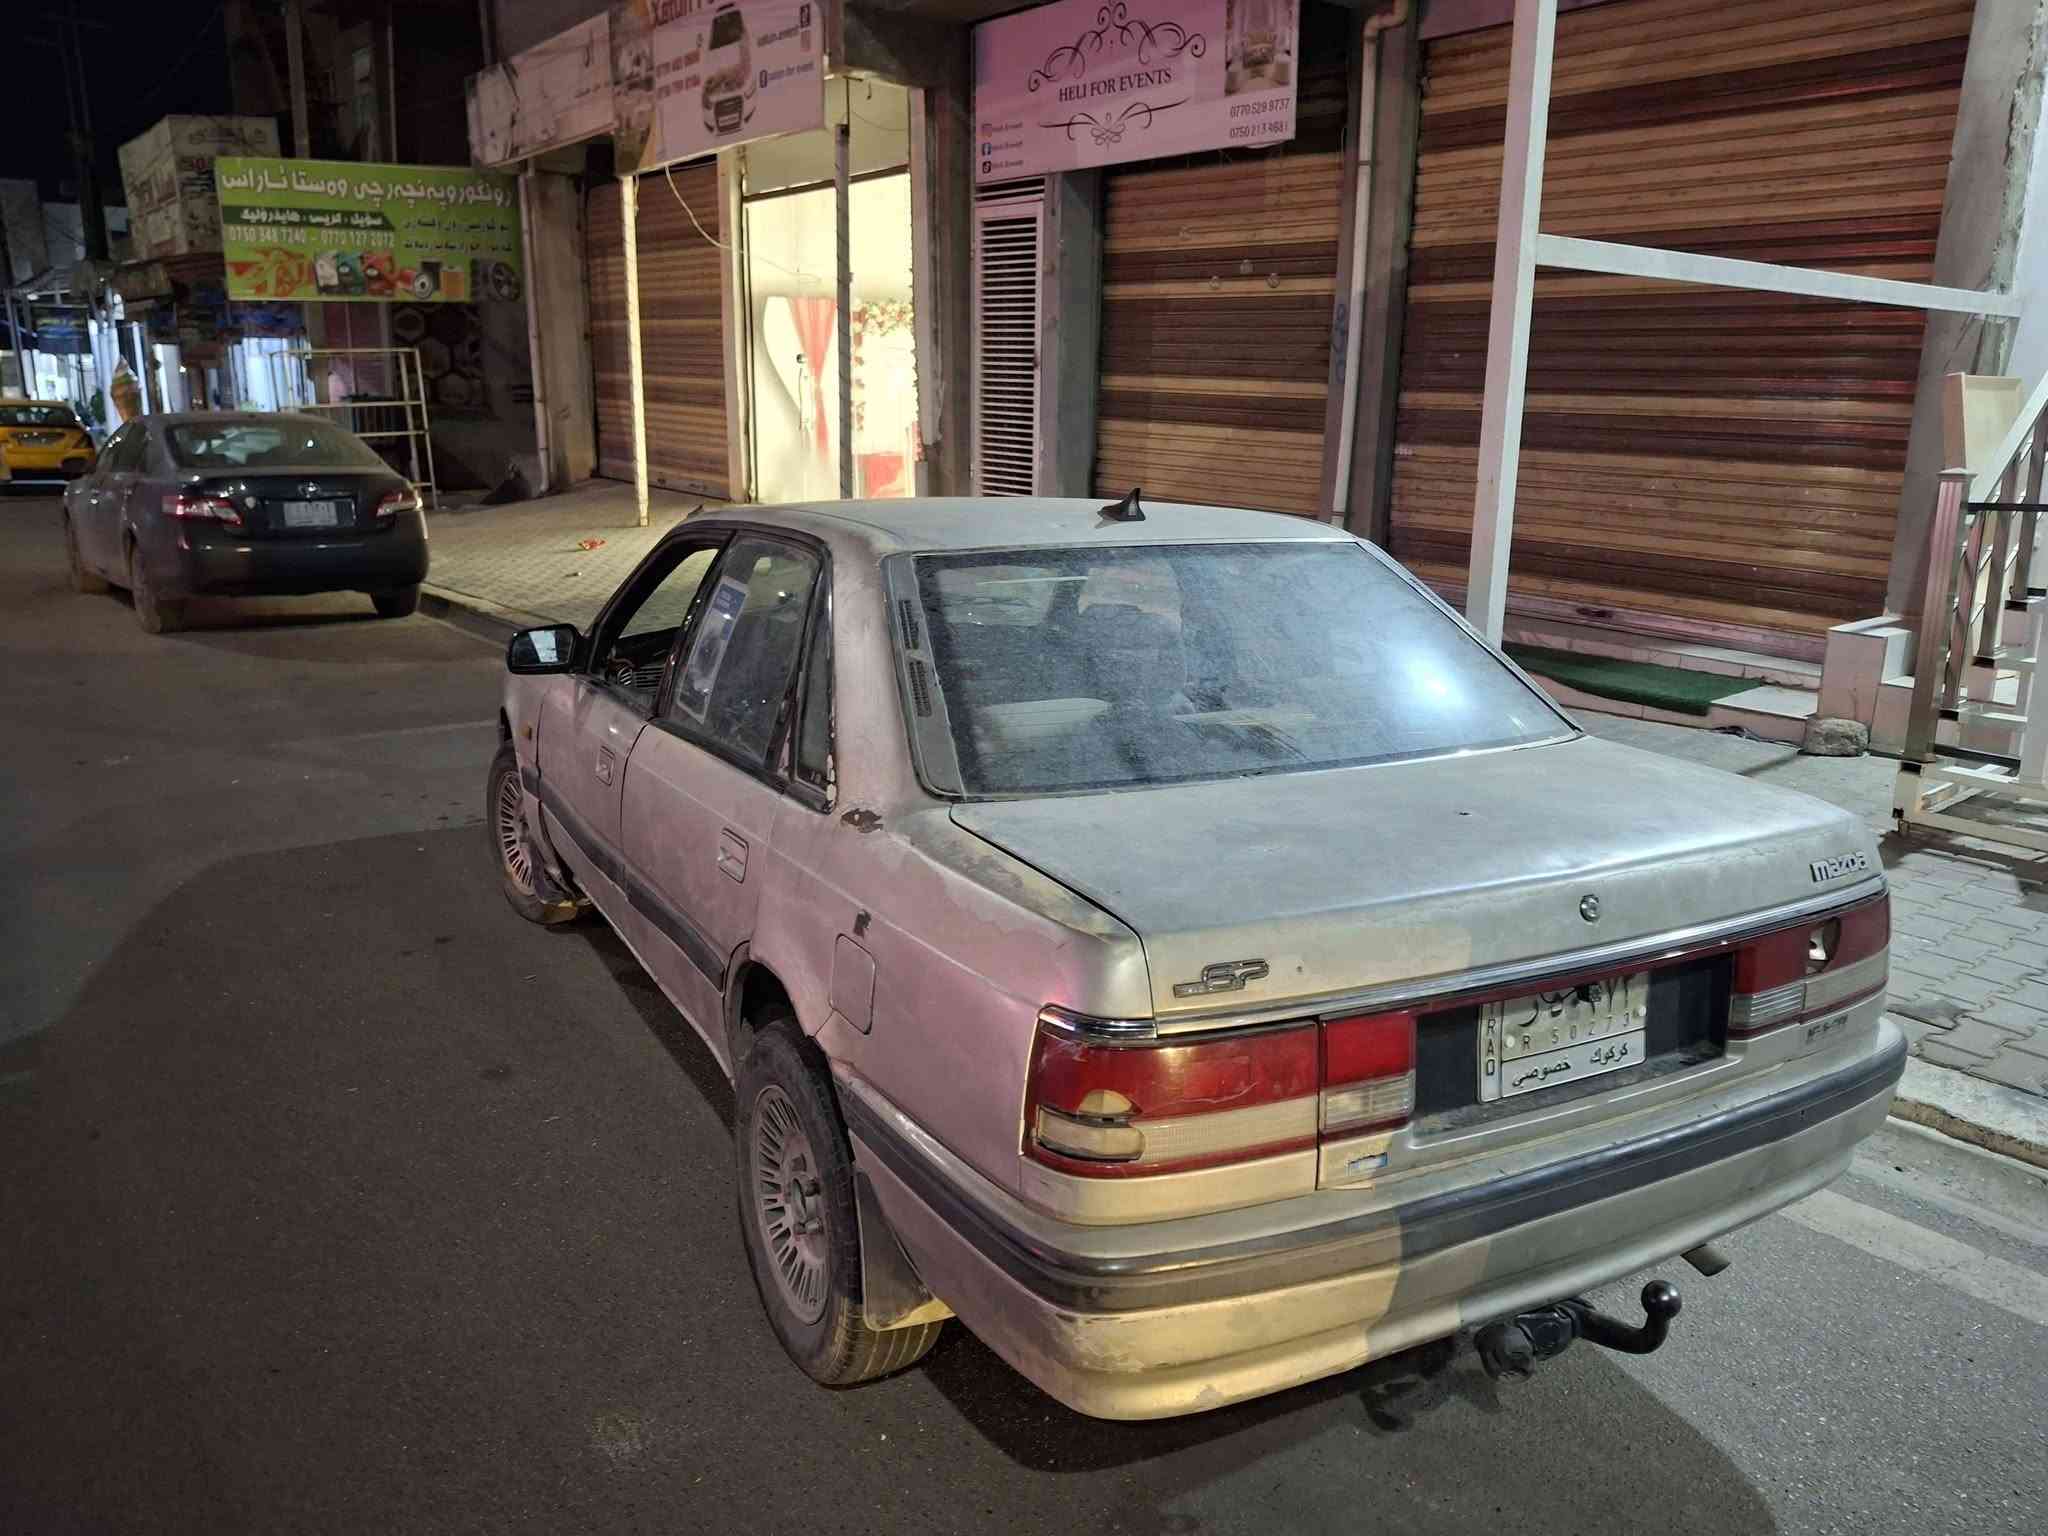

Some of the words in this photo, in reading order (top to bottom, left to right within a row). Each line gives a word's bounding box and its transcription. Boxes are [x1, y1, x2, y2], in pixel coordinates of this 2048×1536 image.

[1058, 83, 1087, 102] HELI
[1090, 77, 1117, 97] FOR
[1120, 67, 1172, 92] EVENTS
